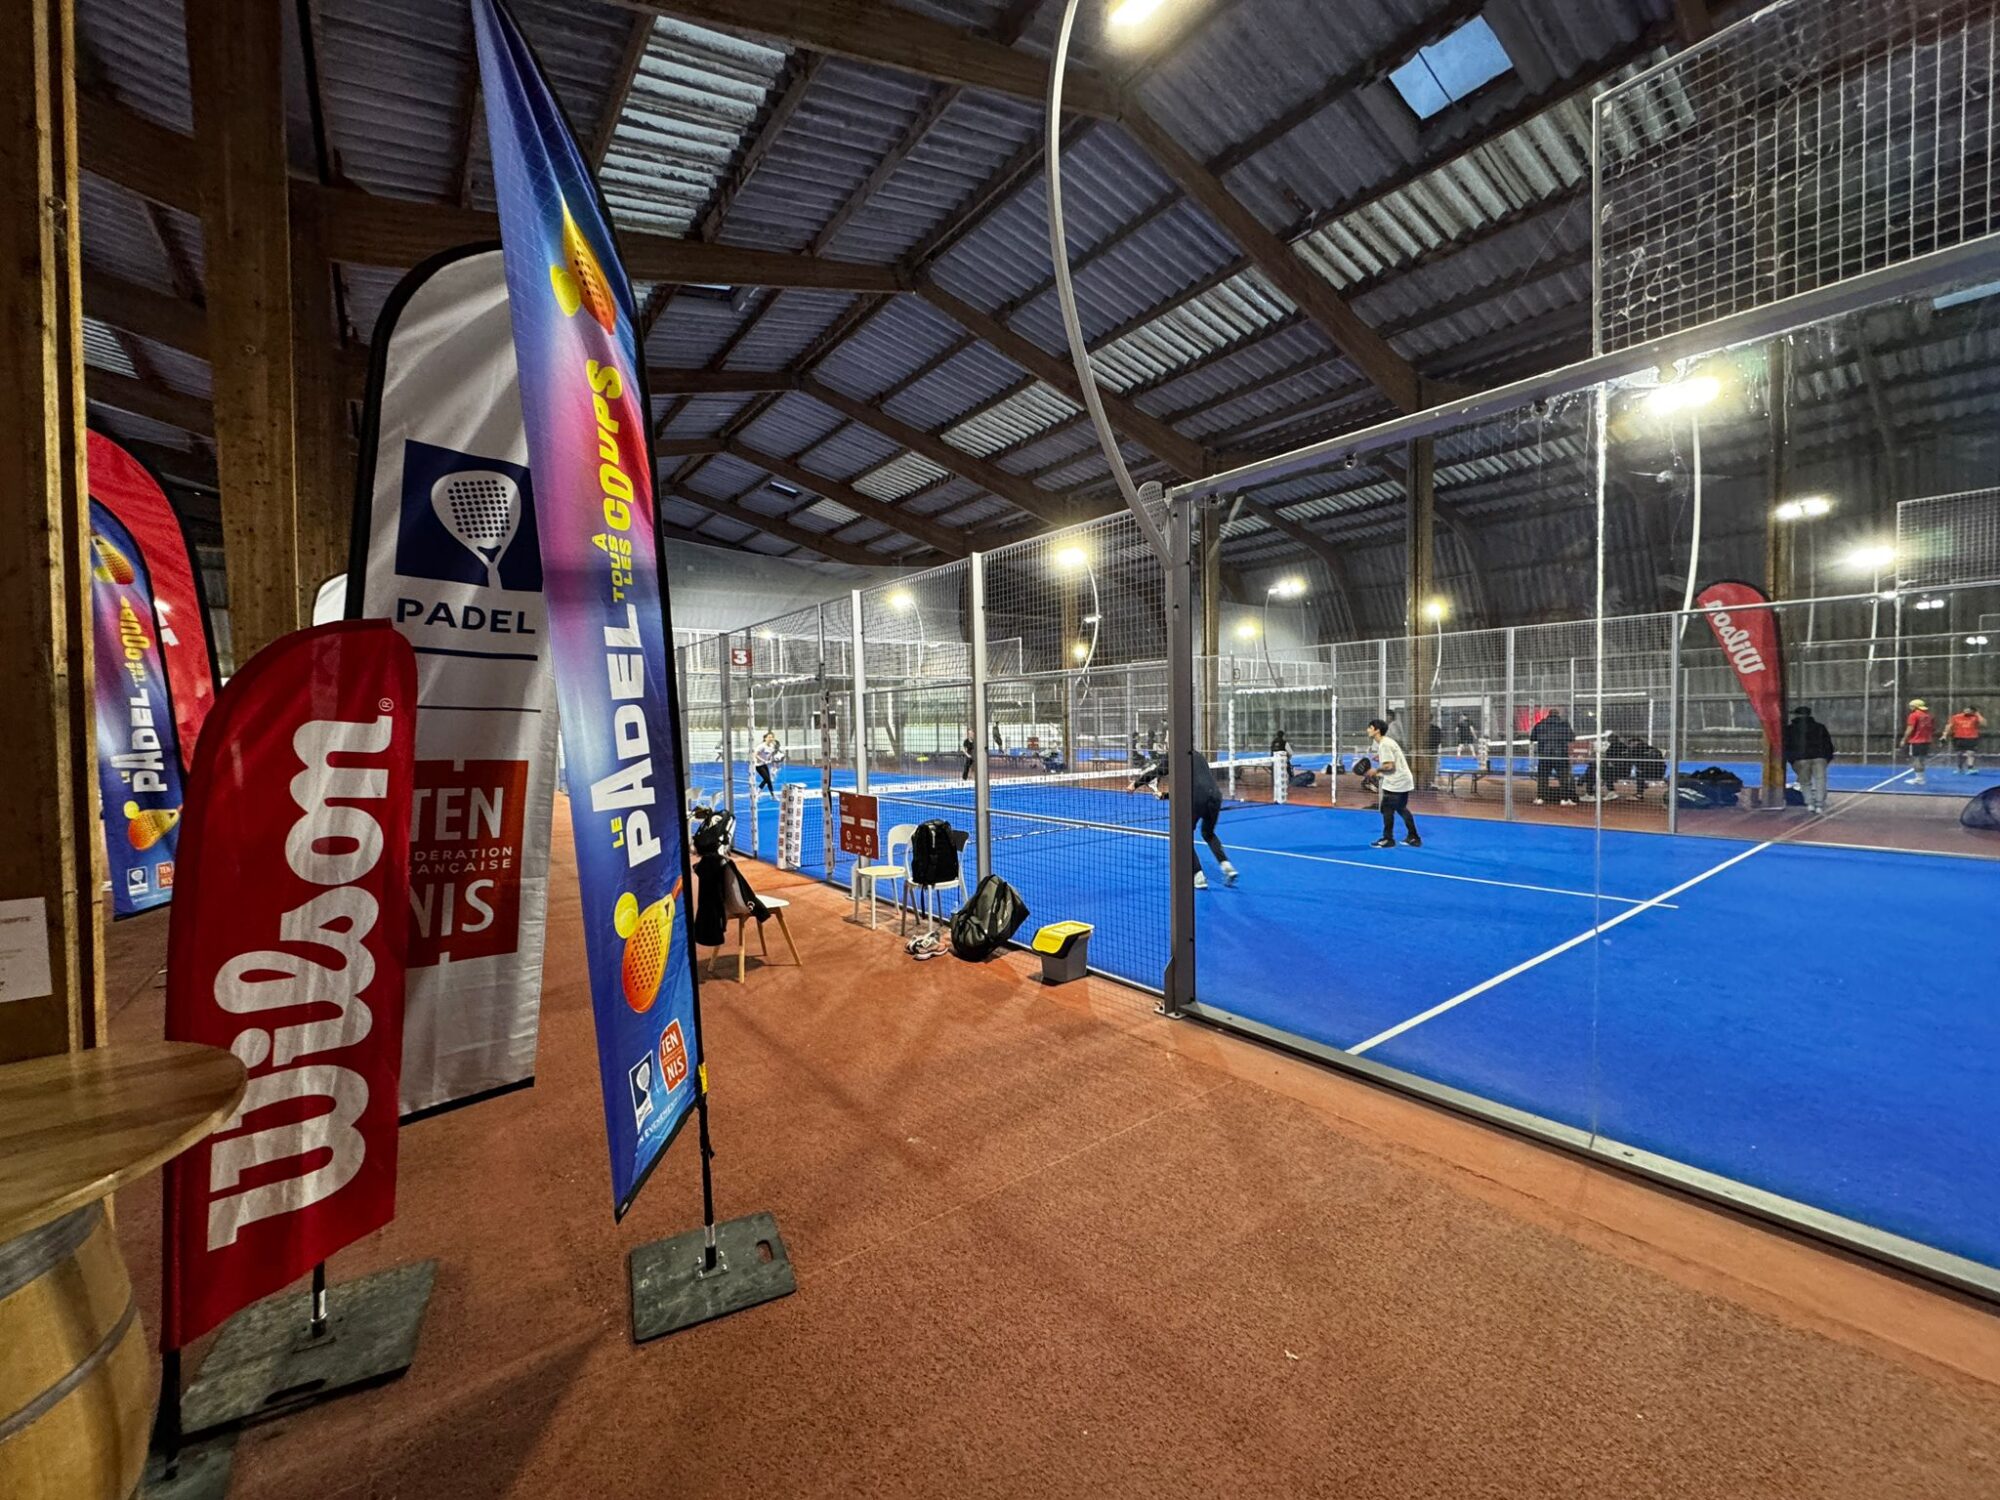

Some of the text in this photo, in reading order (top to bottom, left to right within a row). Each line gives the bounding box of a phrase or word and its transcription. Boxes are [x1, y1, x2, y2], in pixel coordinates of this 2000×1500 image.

[586, 359, 634, 531] COUPS
[608, 534, 625, 602] TOUS
[619, 538, 632, 586] LES
[397, 598, 536, 635] PADEL
[734, 650, 747, 664] 3
[110, 688, 168, 793] PADEL
[590, 603, 661, 868] PADEL
[611, 816, 624, 848] LE
[408, 858, 511, 875] ANÇAISE
[414, 847, 512, 861] DÉRATION
[208, 716, 392, 1250] Wilson
[661, 1031, 679, 1056] TEN
[666, 1056, 685, 1081] NIS
